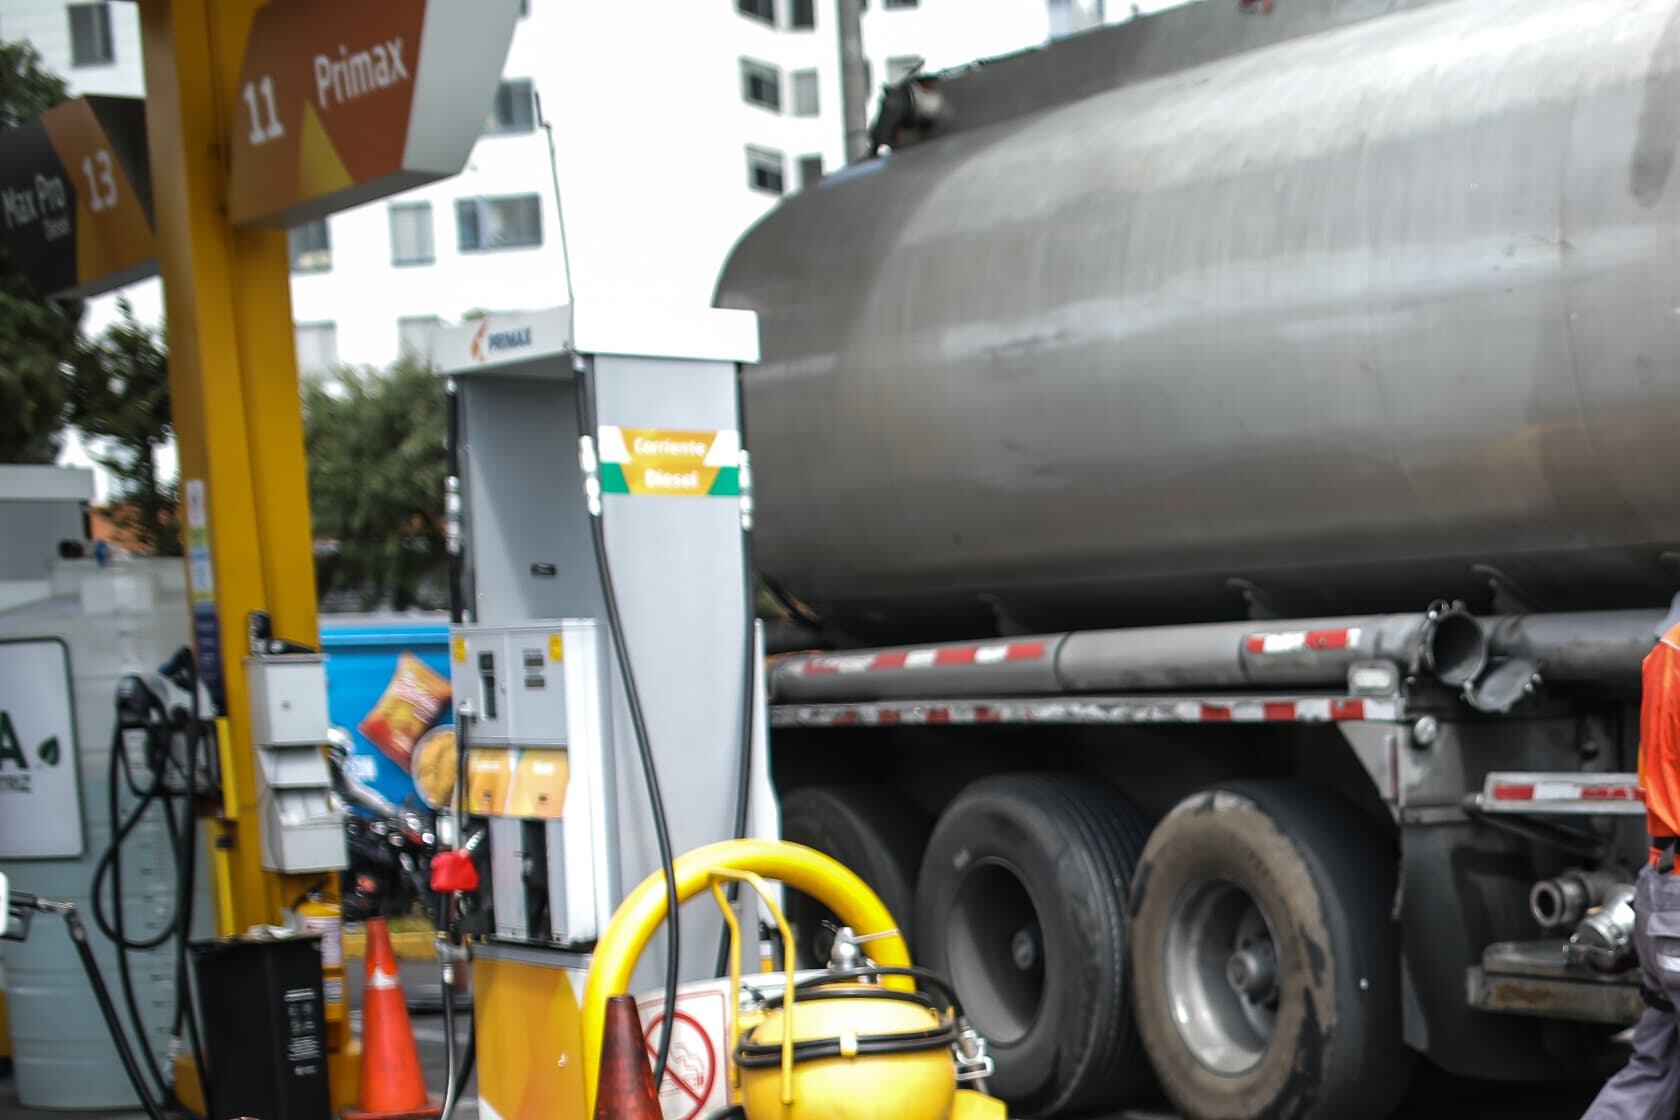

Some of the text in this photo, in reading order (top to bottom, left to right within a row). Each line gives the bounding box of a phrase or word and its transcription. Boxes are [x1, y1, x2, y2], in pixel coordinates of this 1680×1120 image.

[313, 37, 410, 110] Primax
[244, 75, 285, 145] 11
[1, 173, 66, 230] Max Pro
[82, 149, 118, 213] 13
